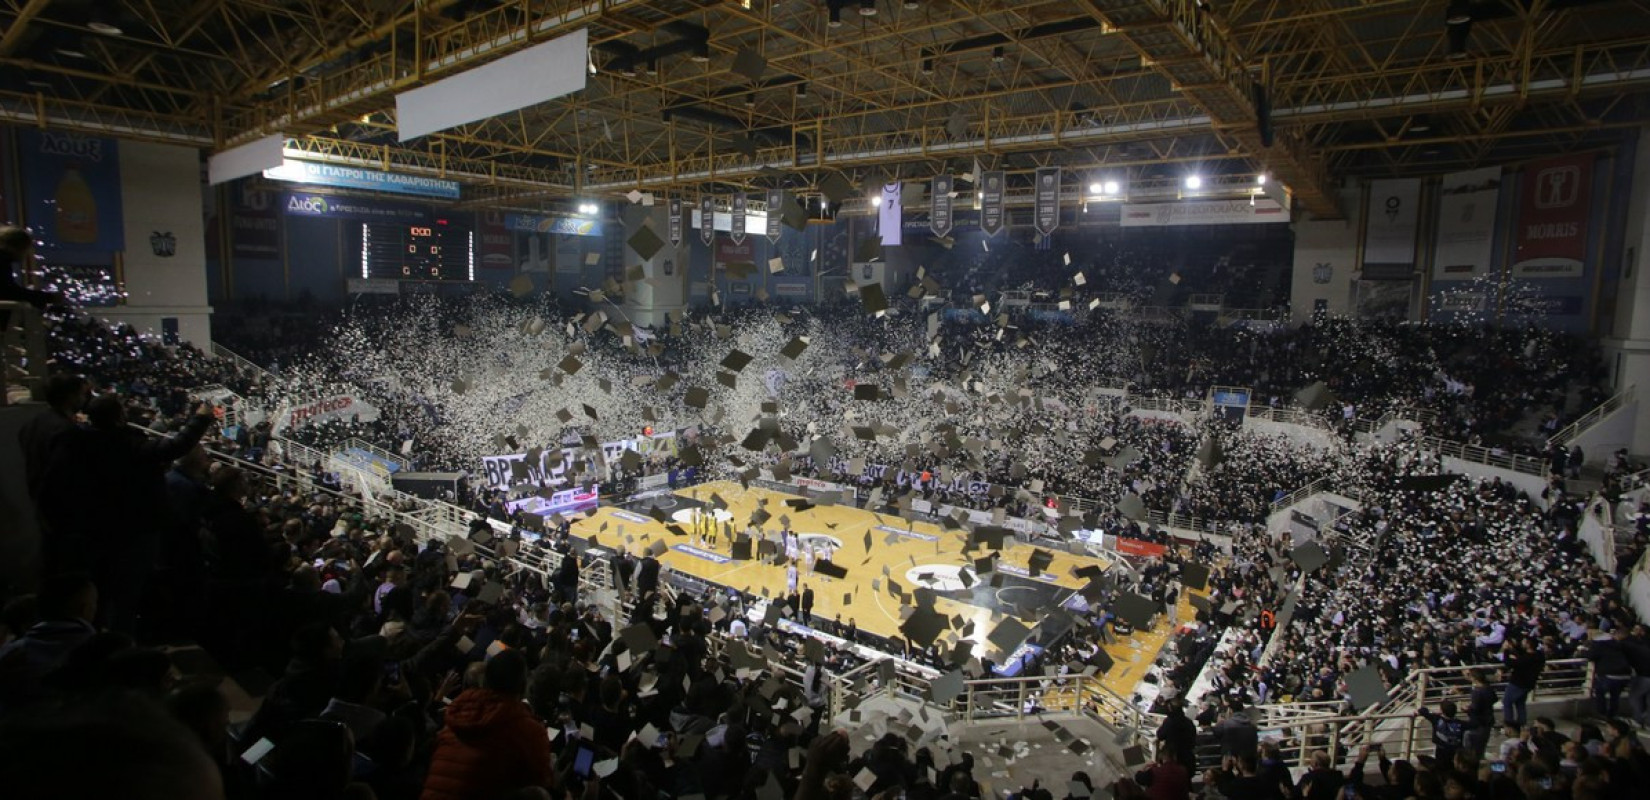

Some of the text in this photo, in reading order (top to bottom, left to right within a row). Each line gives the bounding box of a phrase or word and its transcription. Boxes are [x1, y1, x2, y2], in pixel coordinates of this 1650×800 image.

[308, 165, 320, 175] ΟΙ
[323, 167, 363, 179] ΓΙΑΤΡΟΙ
[366, 171, 385, 182] ΤΗΣ
[387, 174, 458, 190] ΚΑΘΑΡΙΟΤΗΤΑΣ
[288, 195, 321, 214] Διός
[888, 199, 895, 210] 7
[1526, 221, 1579, 240] MORRIS
